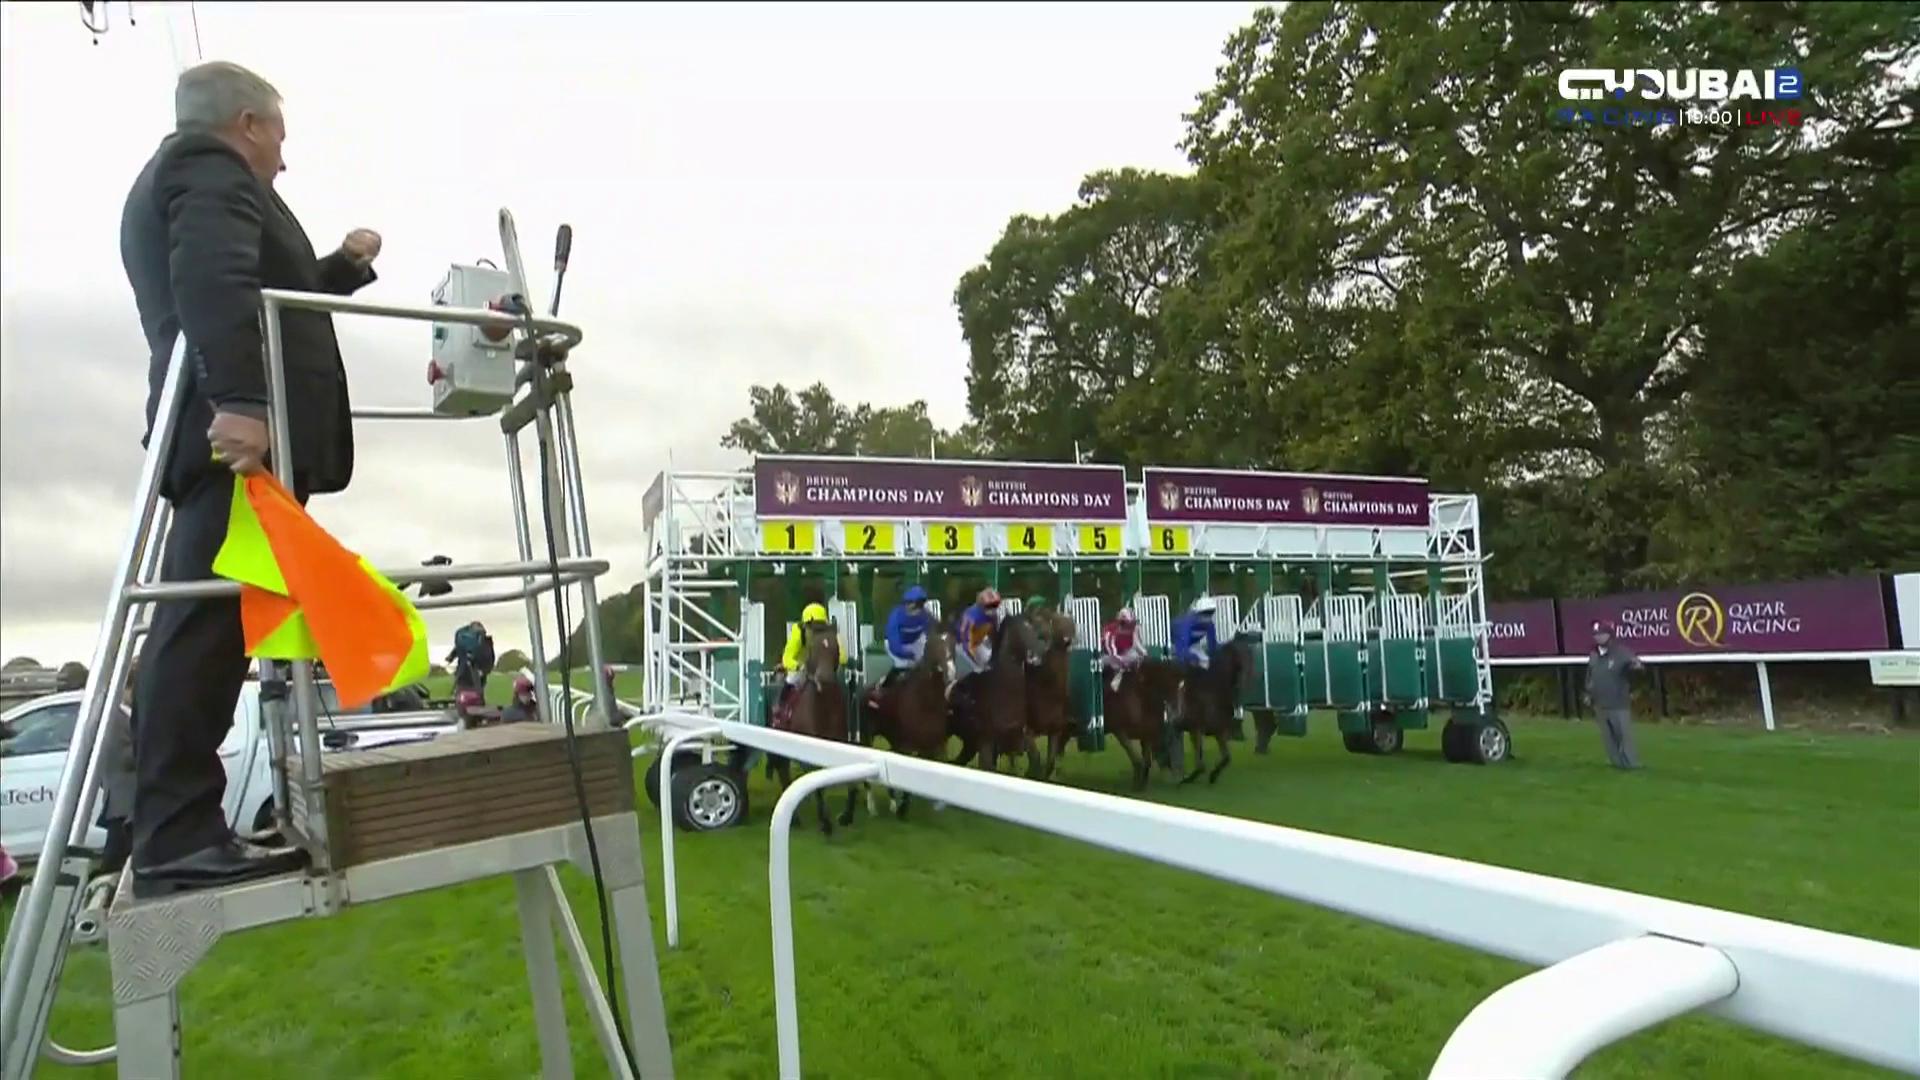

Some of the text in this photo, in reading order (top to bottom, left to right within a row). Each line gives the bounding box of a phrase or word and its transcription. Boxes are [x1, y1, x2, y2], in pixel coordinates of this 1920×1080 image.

[806, 476, 849, 486] BRITISH
[988, 481, 1026, 490] BRITISH
[807, 487, 944, 504] CHAMPIONS DAY
[988, 492, 1111, 507] CHAMPIONS DAY
[1184, 498, 1290, 511] CHAMPIONS DAY
[1323, 501, 1419, 515] CHAMPIONS DAY
[785, 525, 796, 549] 1
[863, 526, 876, 550] 2
[944, 526, 958, 549] 3
[1022, 527, 1036, 549] 4
[1094, 527, 1107, 549] 5
[1162, 528, 1175, 551] 6
[1621, 609, 1668, 622] QATAR
[1729, 602, 1786, 619] QATAR
[1615, 624, 1670, 638] RACING
[1732, 618, 1801, 634] RACING
